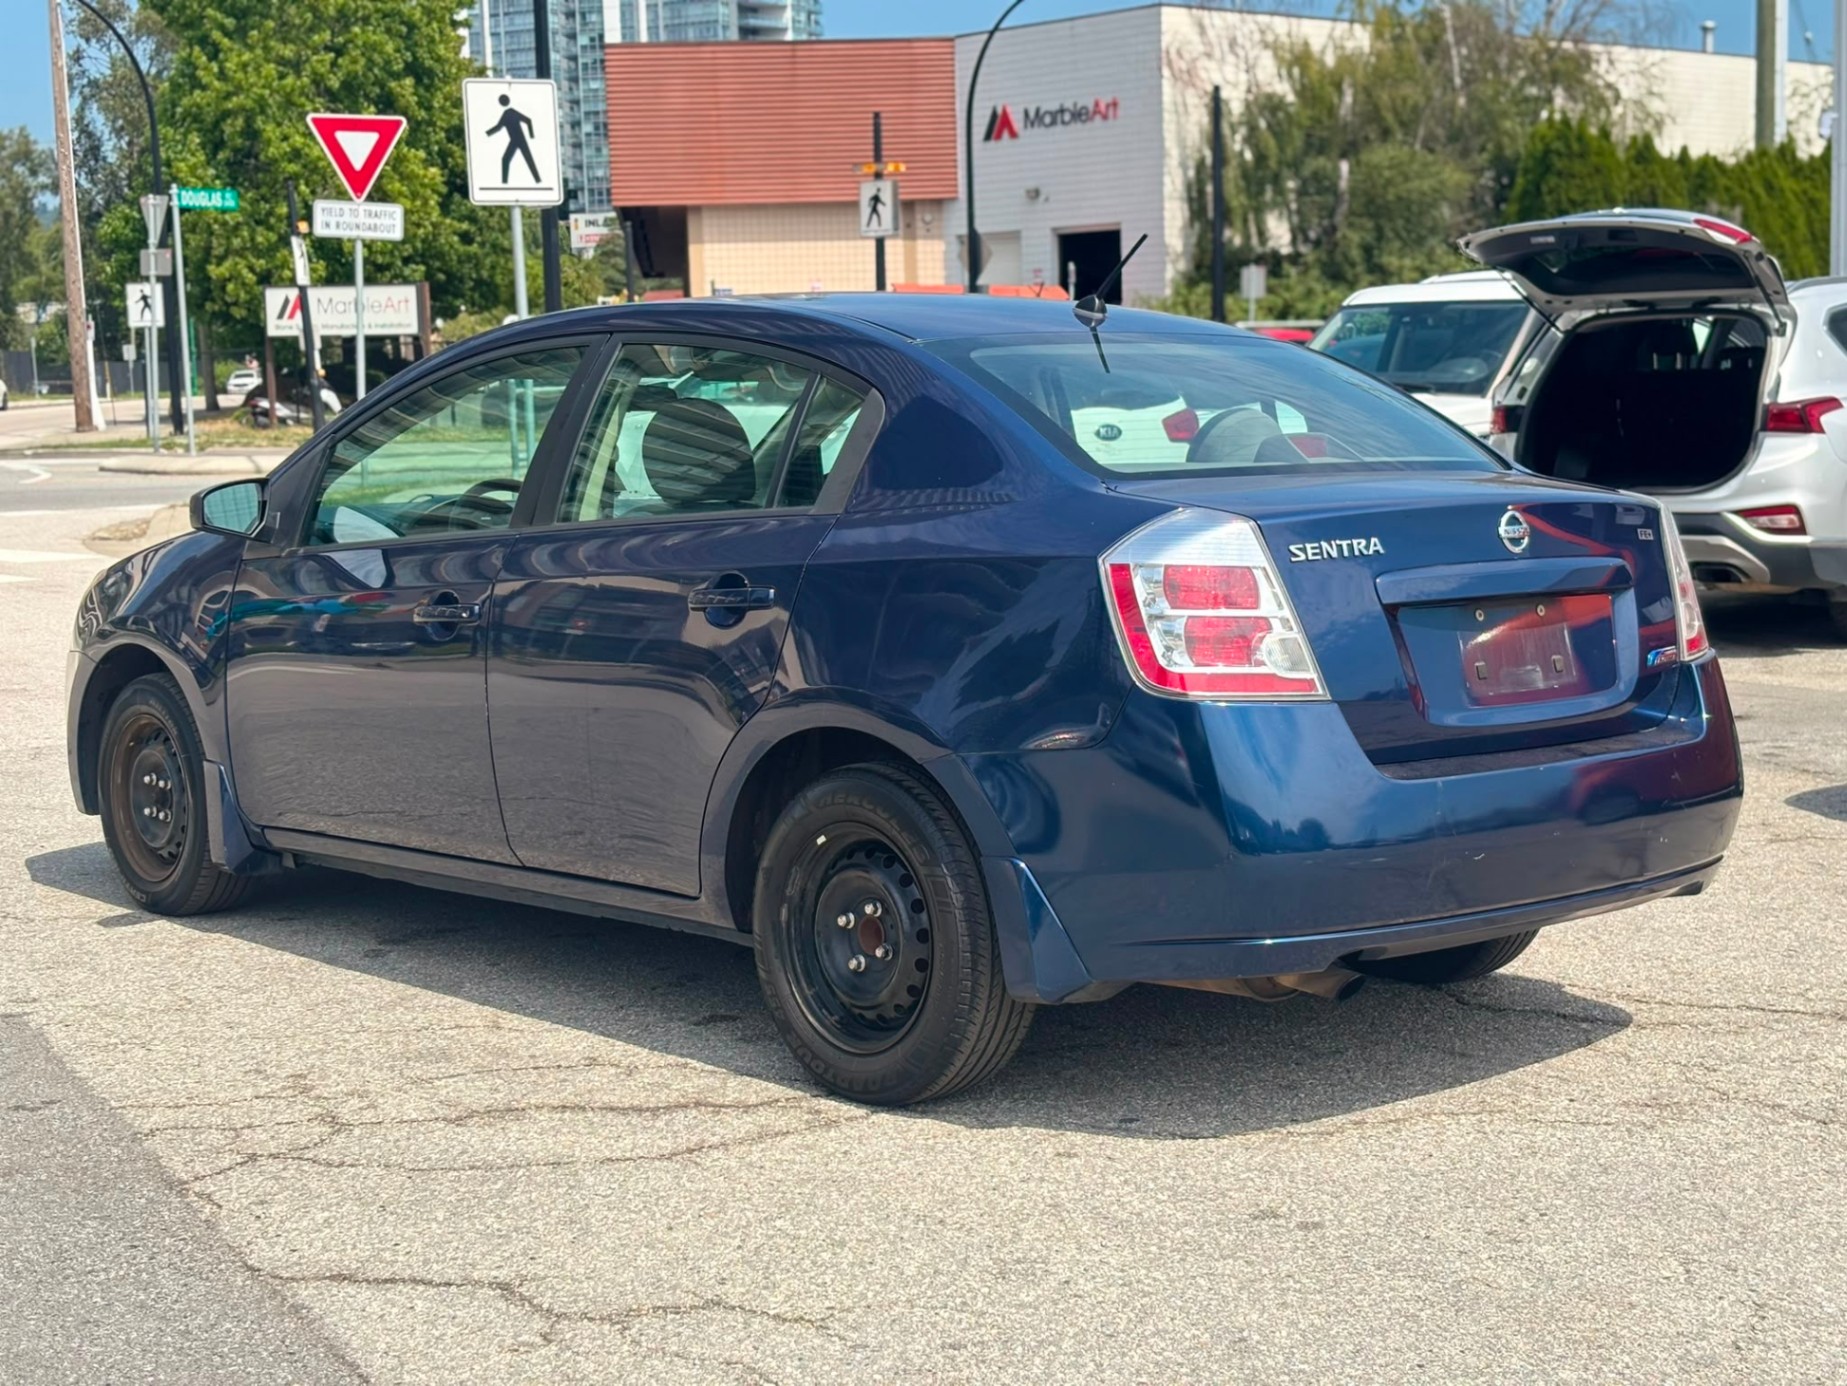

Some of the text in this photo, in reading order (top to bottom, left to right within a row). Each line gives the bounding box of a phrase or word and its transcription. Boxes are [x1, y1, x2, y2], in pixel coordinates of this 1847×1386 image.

[1023, 96, 1119, 130] MarbleArt
[181, 190, 223, 207] DOUGLAS
[321, 207, 397, 220] YIELD TO TRAFFIC
[321, 220, 397, 234] IN ROUNDABOUT
[1100, 426, 1119, 438] KIA
[1288, 536, 1386, 562] SENTRA
